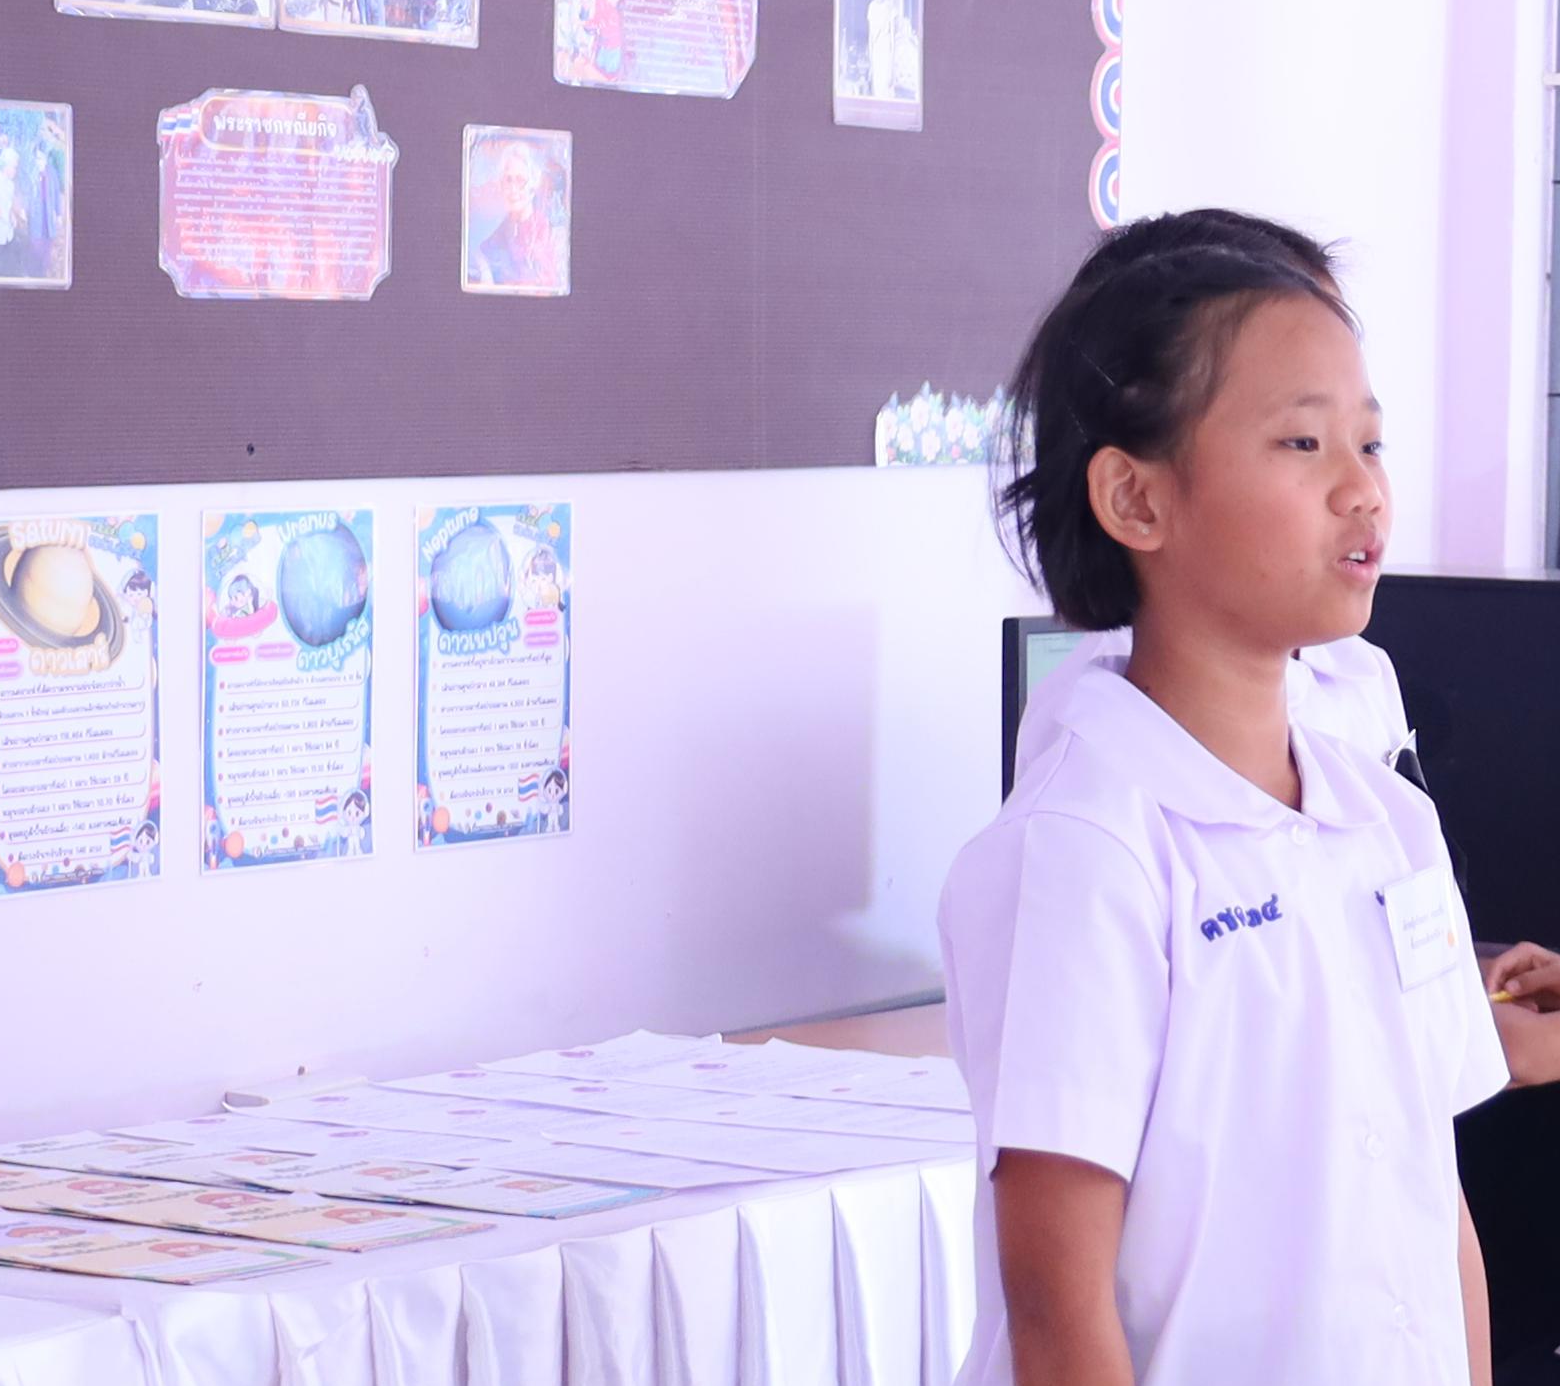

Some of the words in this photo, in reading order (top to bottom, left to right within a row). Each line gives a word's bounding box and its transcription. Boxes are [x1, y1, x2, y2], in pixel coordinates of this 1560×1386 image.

[213, 113, 338, 138] พระราชกรณียกิจ
[11, 519, 86, 549] Saturn
[278, 512, 337, 543] Uranus
[422, 507, 480, 562] Neptune
[297, 616, 369, 671] ดาวยูเรนัส
